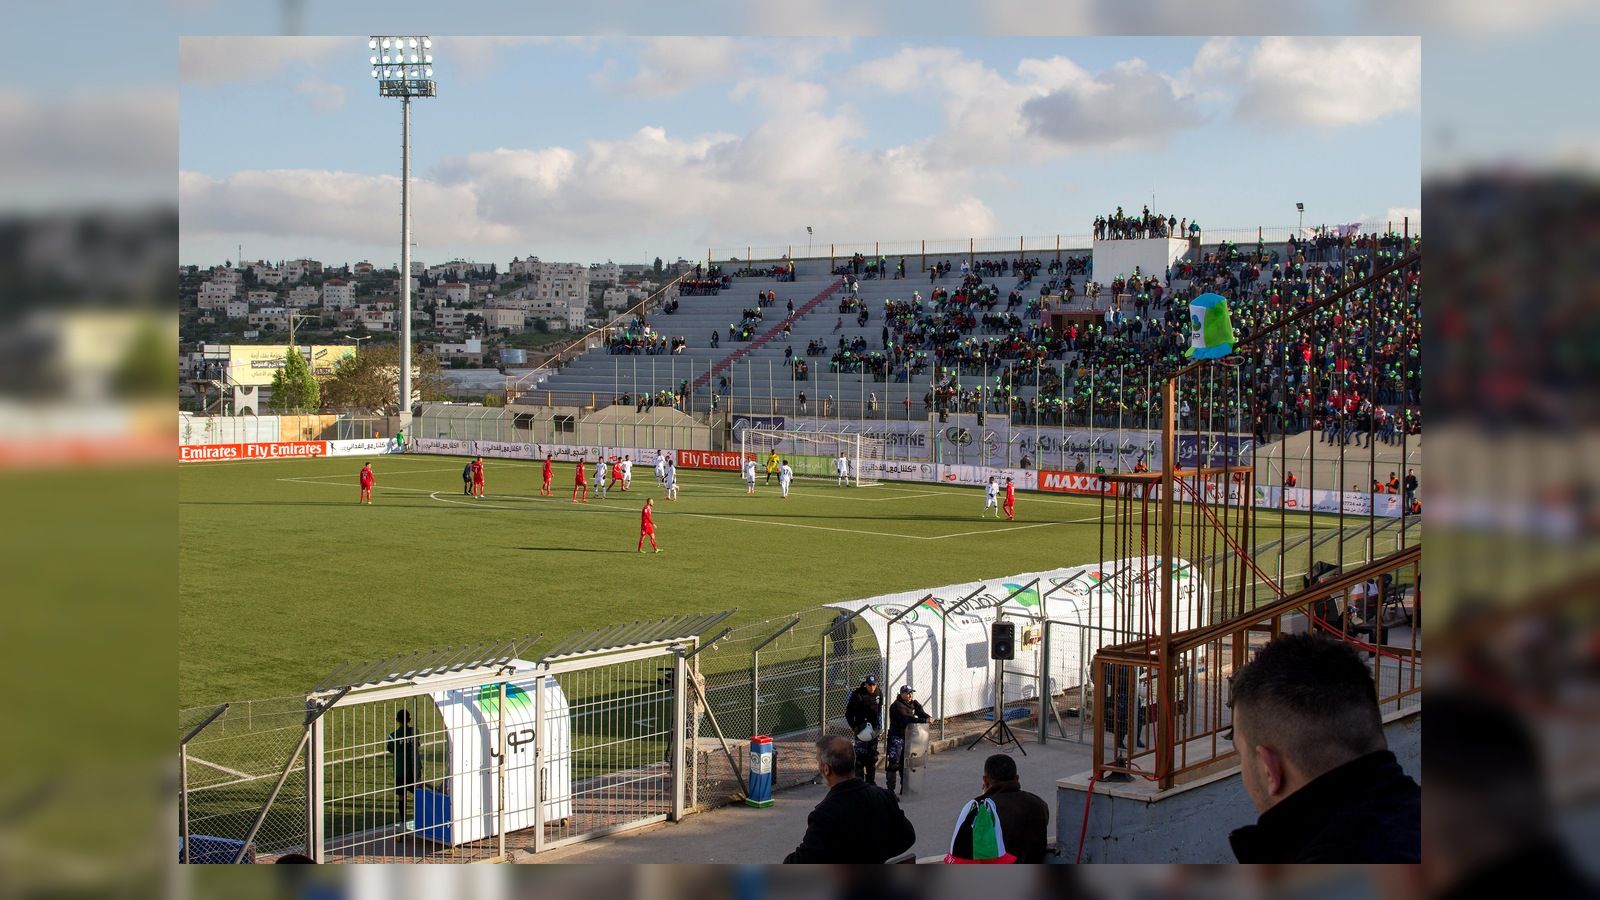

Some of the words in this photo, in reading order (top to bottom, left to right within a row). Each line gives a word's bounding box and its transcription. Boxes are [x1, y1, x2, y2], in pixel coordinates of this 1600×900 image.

[181, 446, 237, 459] Emirates
[247, 444, 268, 459] Fly
[270, 443, 322, 456] Emirates
[682, 452, 700, 467] Fly
[703, 453, 746, 468] Emirat
